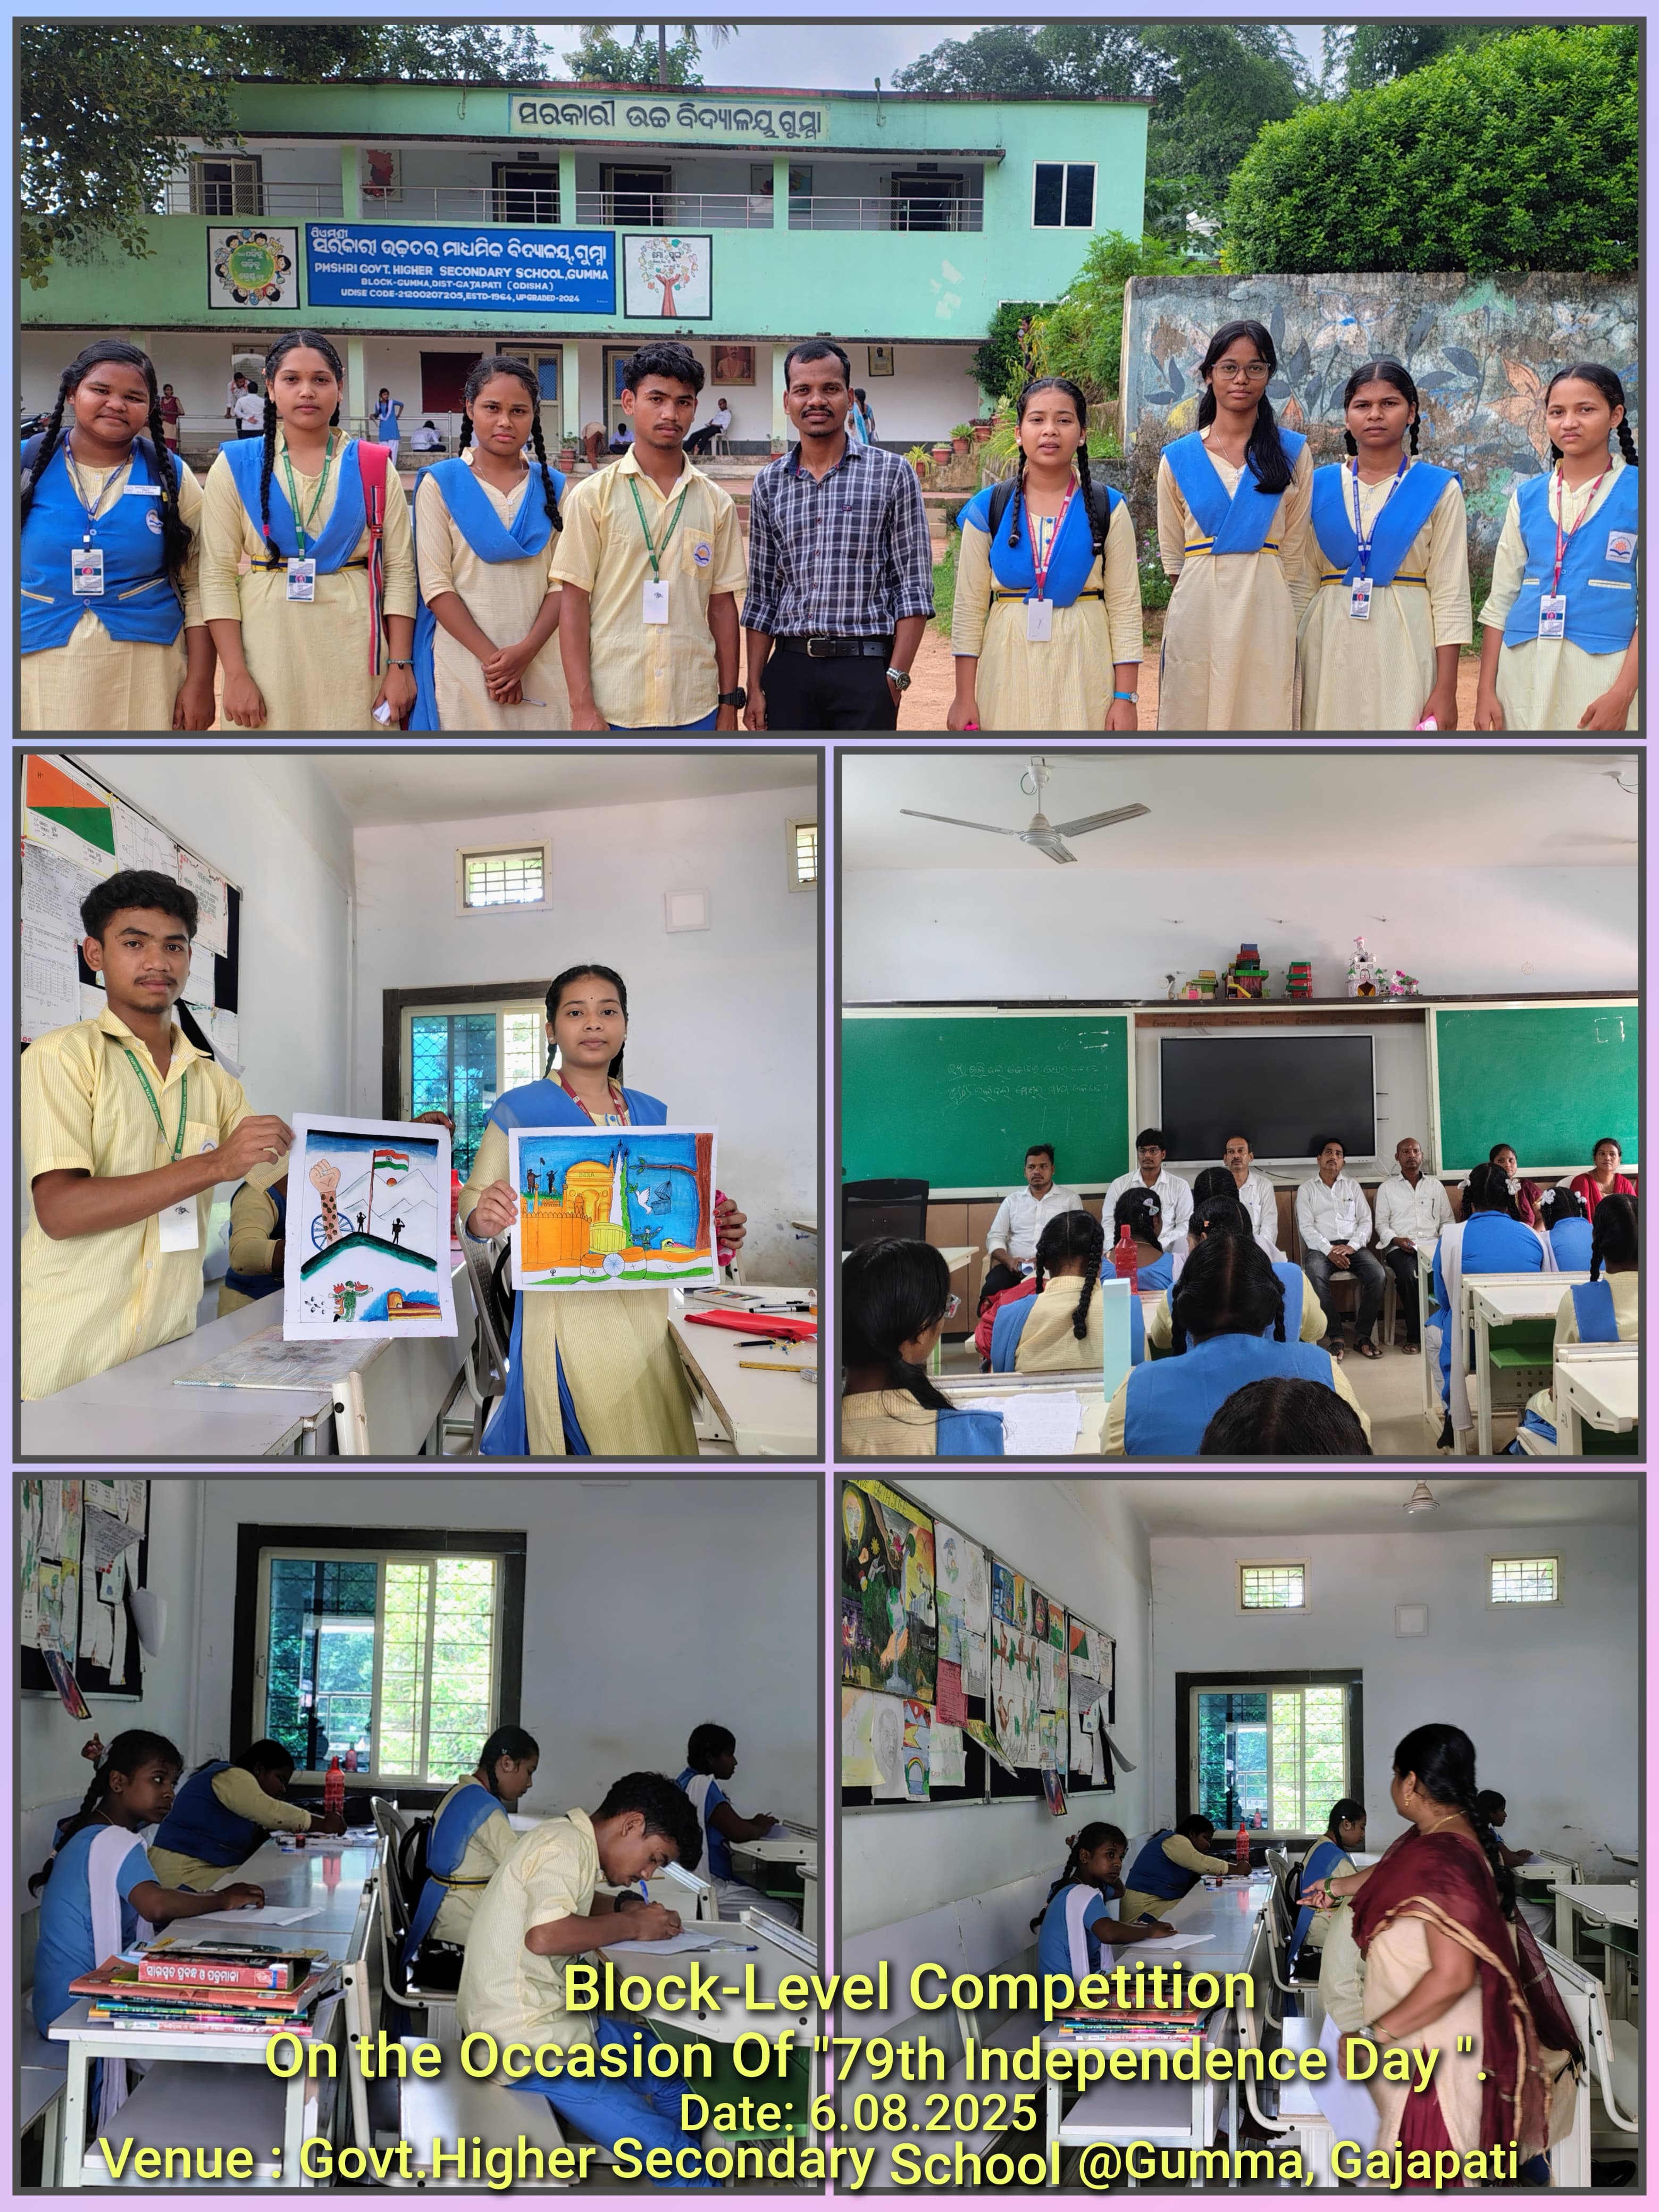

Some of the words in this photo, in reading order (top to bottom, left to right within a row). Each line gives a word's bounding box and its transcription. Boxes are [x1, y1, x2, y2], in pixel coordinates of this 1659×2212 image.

[518, 100, 615, 127] ସରକାରୀ
[626, 105, 670, 128] ଉଚ୍ଚ
[779, 109, 821, 139] ଗୁମ୍ମା
[313, 238, 376, 256] ସରକାରୀ
[442, 237, 502, 257] ମାଧ୍ୟମିକ
[314, 263, 357, 273] PMSHRI
[359, 264, 391, 275] GOVT.
[393, 265, 433, 275] HIGHER
[439, 266, 512, 277] SECONDARY
[361, 278, 502, 290] BLOCK-GUMMA,DIST-GAJAPATI
[507, 281, 554, 291] (ODISHA)
[341, 288, 367, 297] UDISE
[127, 1053, 140, 1073] GAJAPATI
[199, 1970, 205, 1980] ଓ
